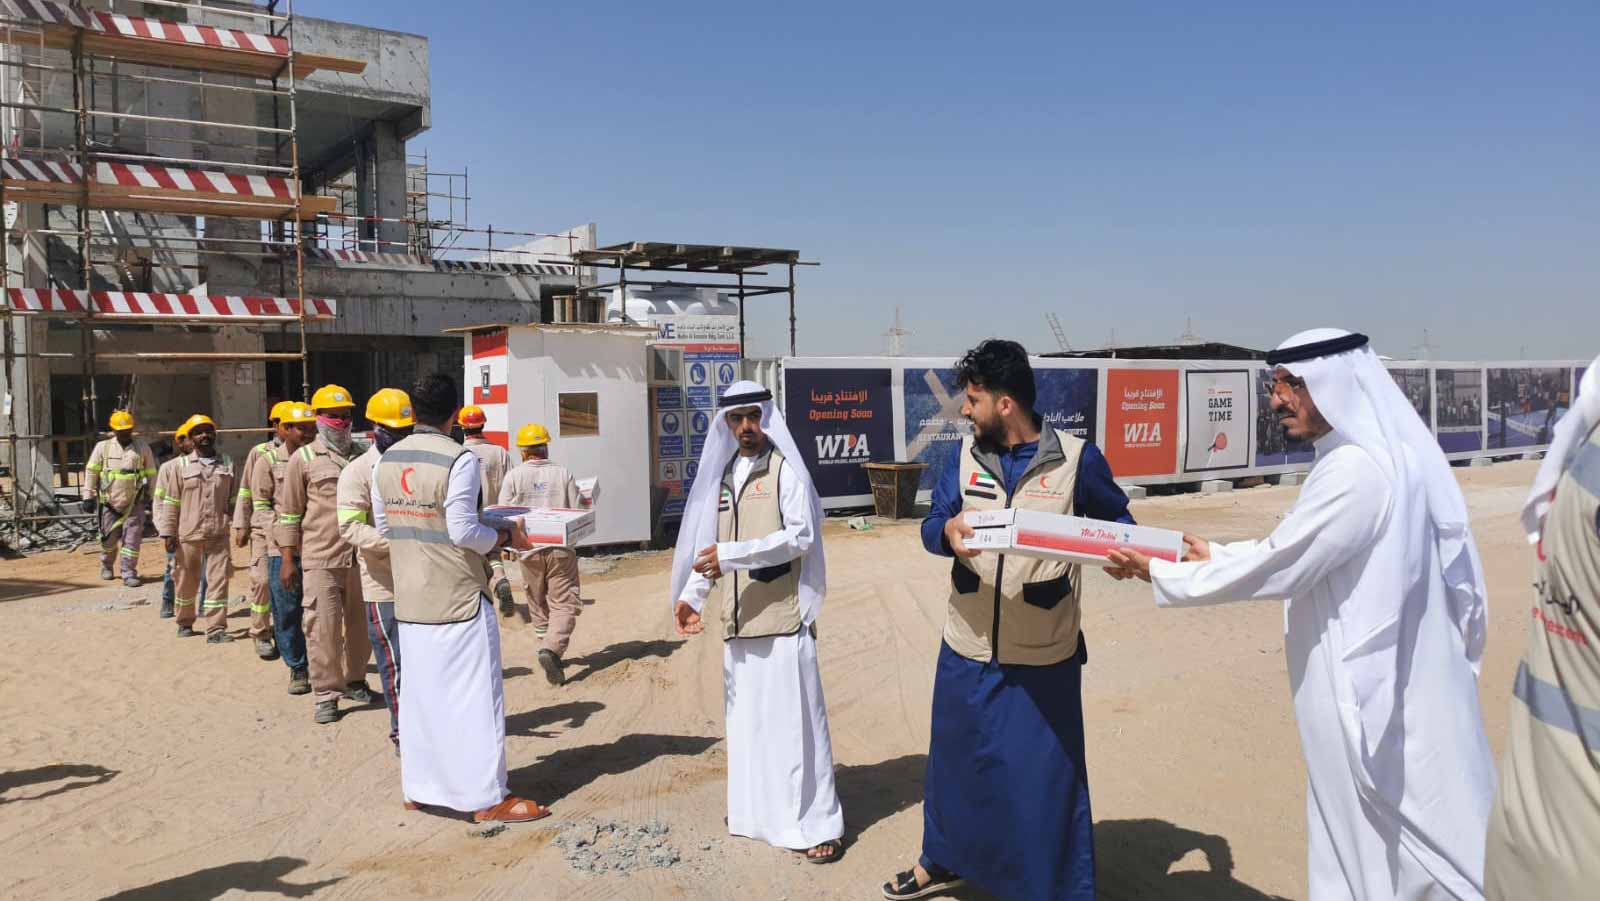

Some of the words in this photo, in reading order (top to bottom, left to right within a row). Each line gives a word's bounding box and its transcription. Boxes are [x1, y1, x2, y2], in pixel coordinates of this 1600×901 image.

[1208, 397, 1232, 408] GAME
[809, 409, 849, 421] Opening
[850, 408, 873, 418] Soon
[1208, 411, 1232, 422] TIME
